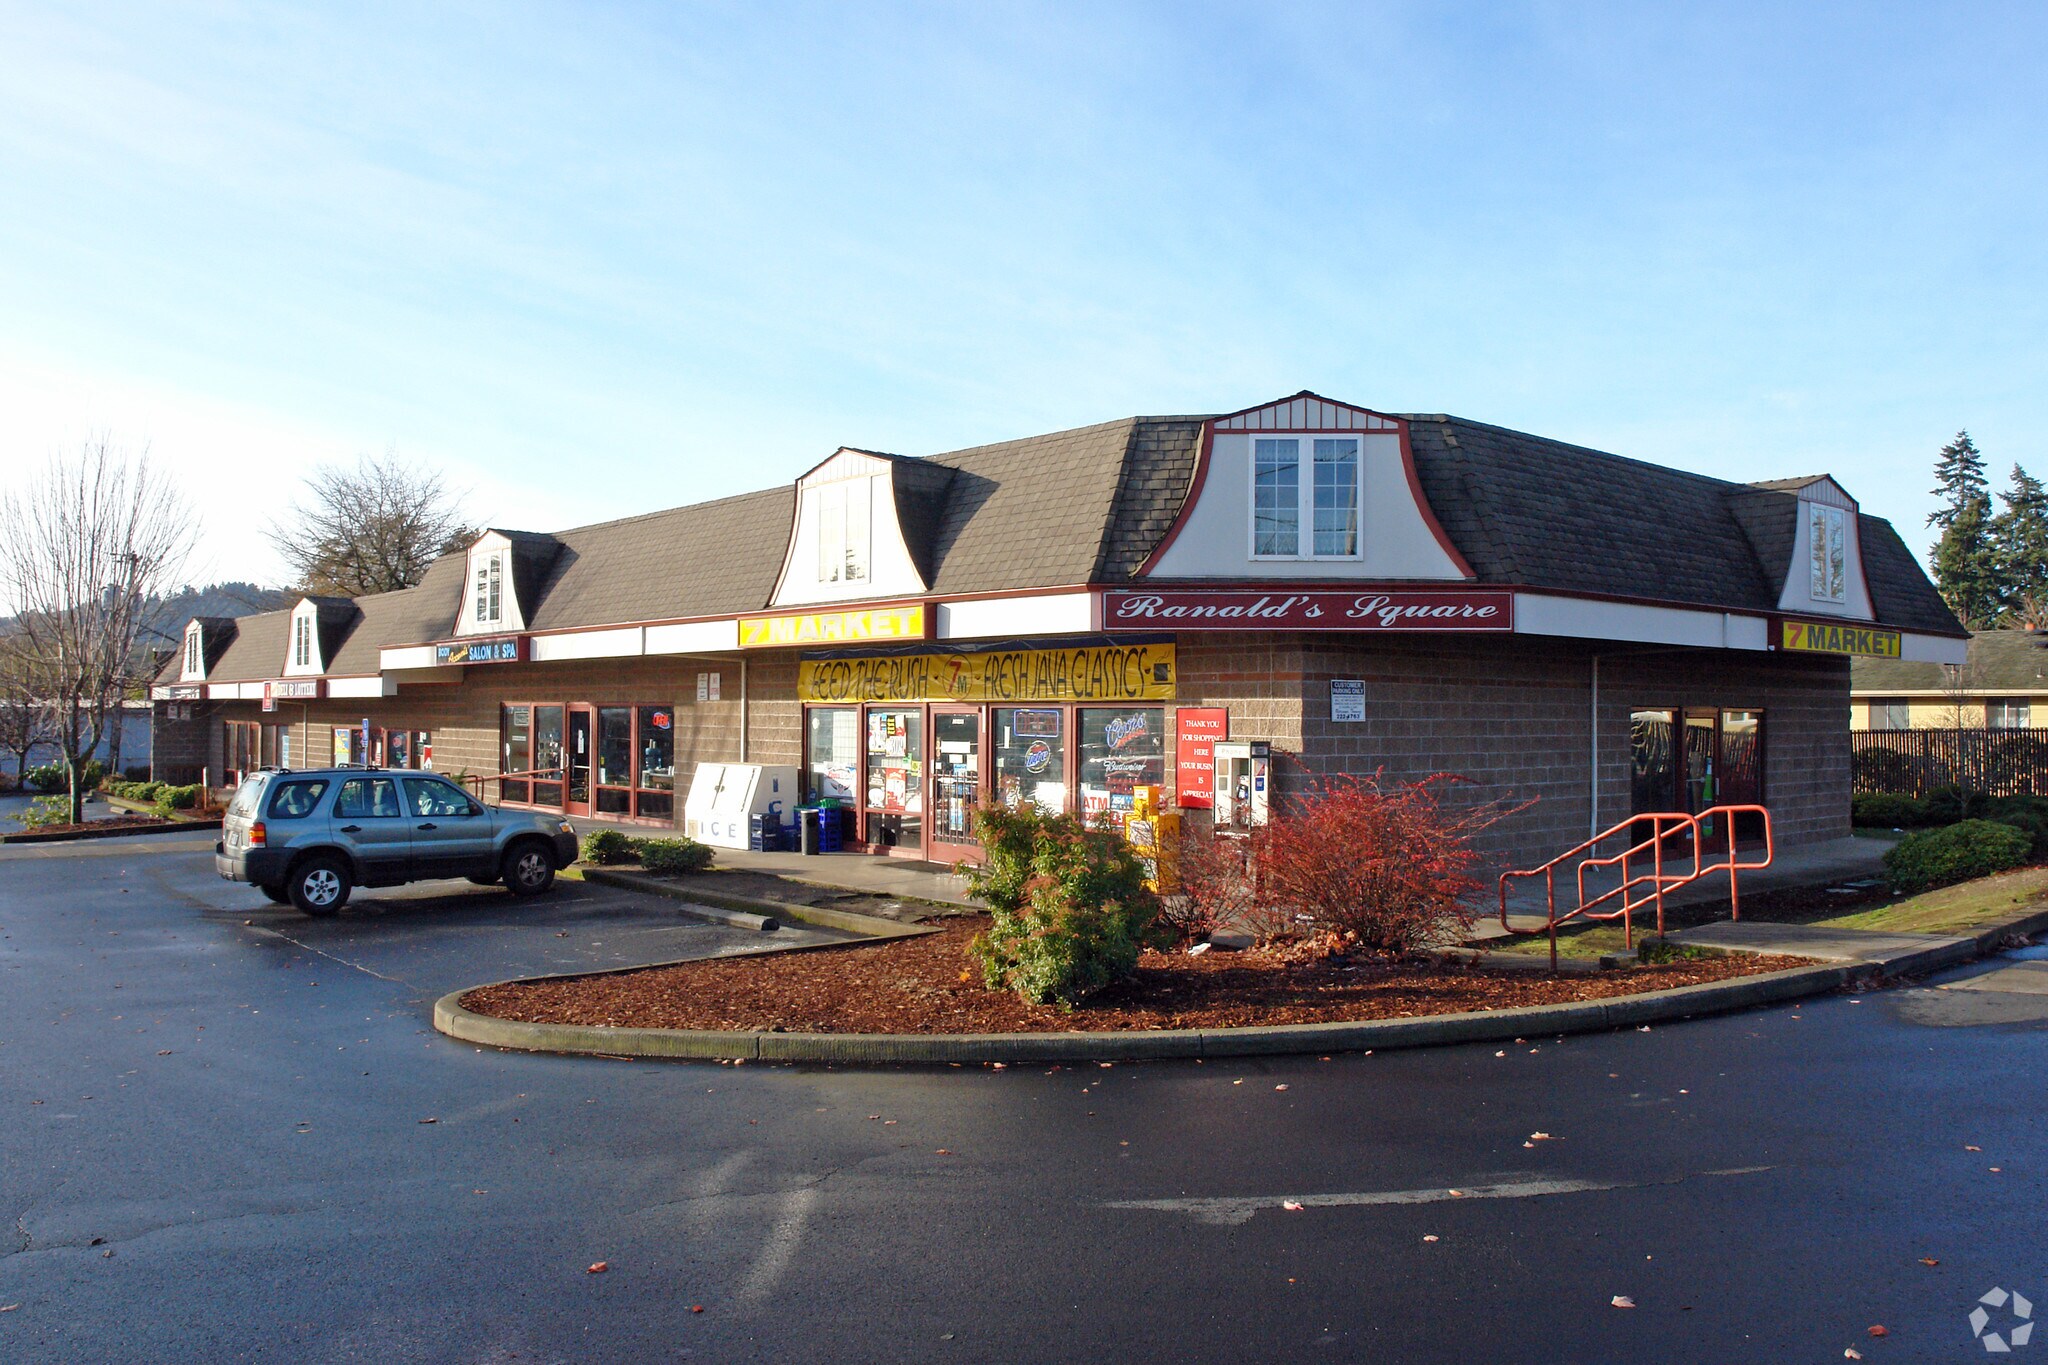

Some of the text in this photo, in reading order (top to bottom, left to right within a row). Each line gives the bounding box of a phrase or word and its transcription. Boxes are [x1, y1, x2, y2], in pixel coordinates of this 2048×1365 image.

[1115, 595, 1499, 627] Ranald's Square
[744, 608, 917, 644] 7 MARKET
[1787, 623, 1897, 655] 7 MARKET
[469, 645, 492, 661] SALON
[494, 645, 499, 658] &
[502, 643, 516, 658] SPA
[811, 661, 851, 700] FEED
[856, 659, 888, 700] THE
[889, 657, 930, 700] RUSH
[984, 652, 1030, 700] FRESH
[1031, 651, 1067, 699] JAVA
[1071, 647, 1148, 698] CLASSICS
[1105, 712, 1147, 748] Coors
[1185, 720, 1220, 728] THANK YOU
[1193, 748, 1209, 756] HERE
[1196, 762, 1214, 770] BUSIN
[1198, 776, 1204, 784] IS
[1084, 796, 1108, 811] ATM
[700, 821, 737, 838] ICE
